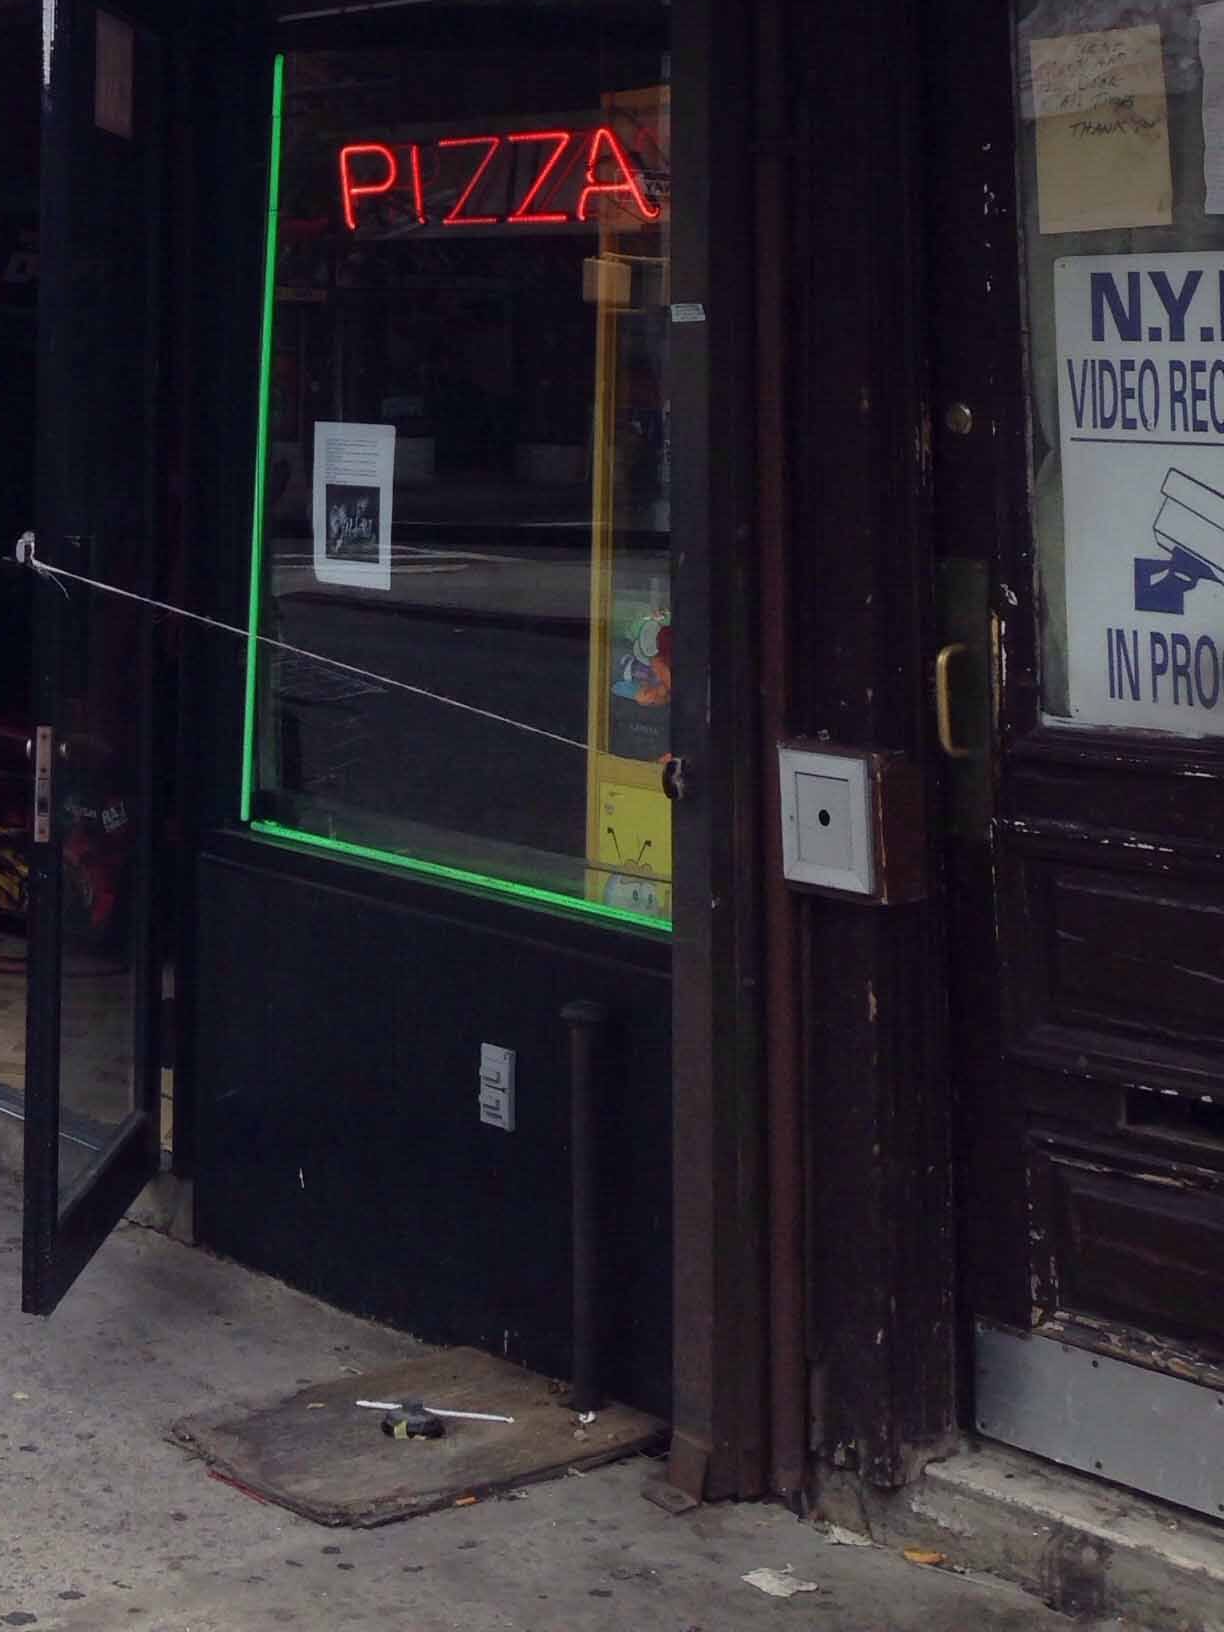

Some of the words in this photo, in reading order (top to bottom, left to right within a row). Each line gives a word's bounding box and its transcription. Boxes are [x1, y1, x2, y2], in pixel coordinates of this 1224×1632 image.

[338, 126, 662, 252] PIZZA
[1089, 270, 1224, 343] N.Y.
[1066, 358, 1161, 432] VIDEO
[1107, 628, 1141, 702] IN
[1150, 631, 1224, 712] PRO
